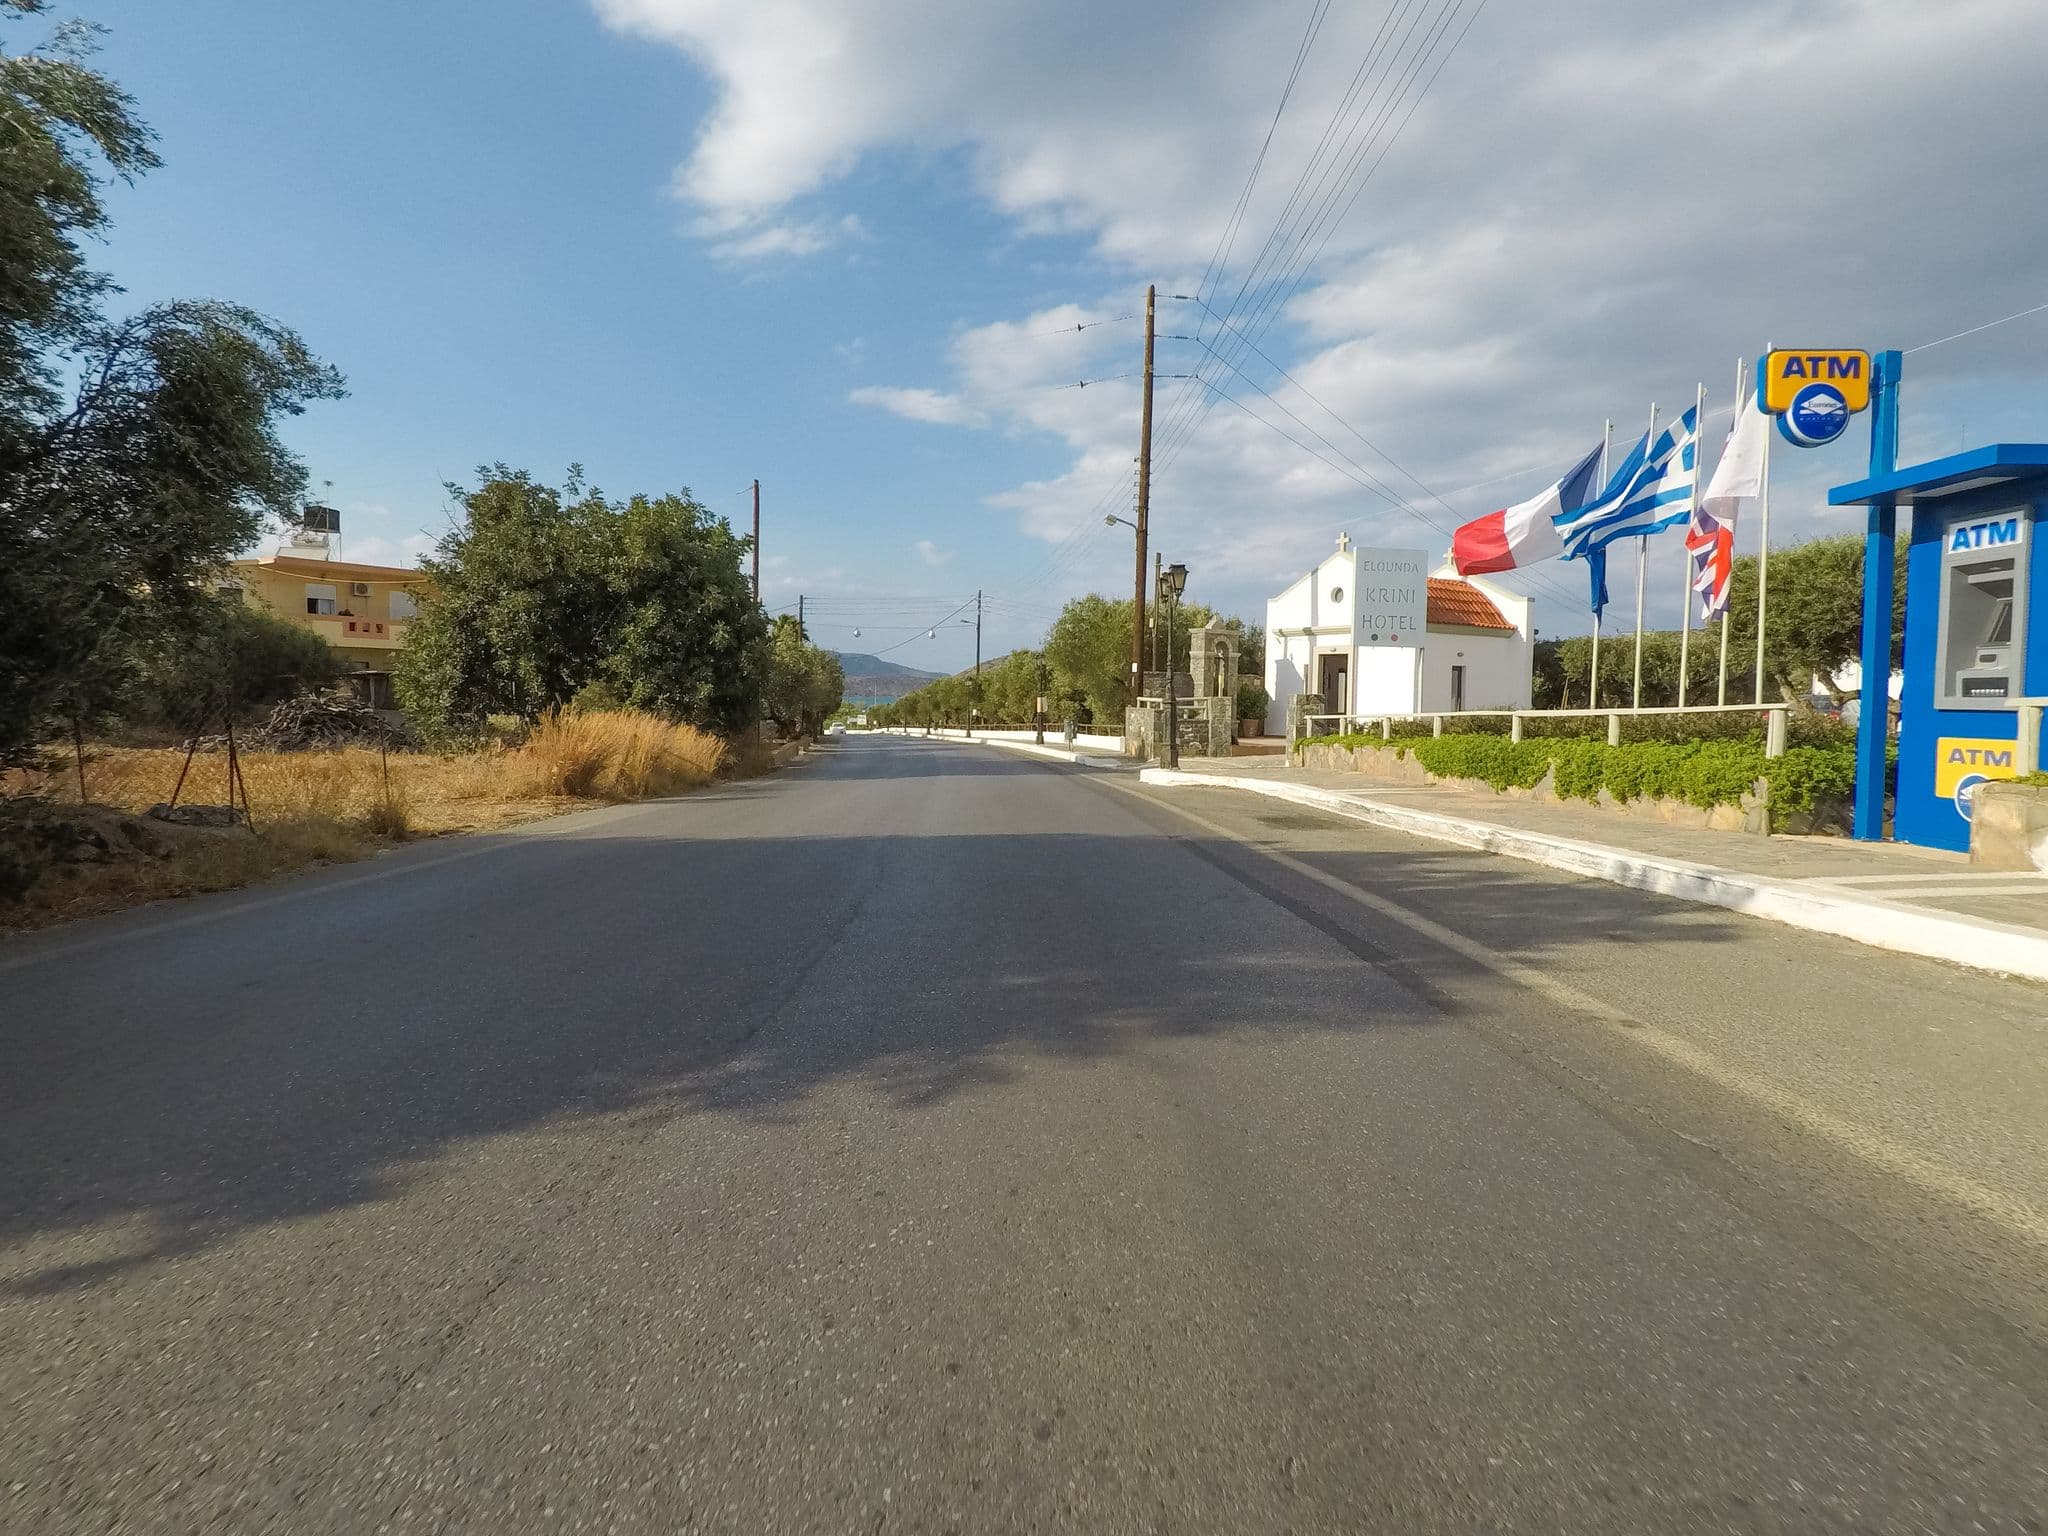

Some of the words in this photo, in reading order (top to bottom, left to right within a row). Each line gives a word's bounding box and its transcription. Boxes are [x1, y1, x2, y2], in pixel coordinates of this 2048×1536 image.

[1782, 356, 1861, 378] ATM
[1952, 518, 2017, 550] ATM
[1363, 560, 1419, 573] ELOUNDA
[1365, 587, 1416, 604] KRINI
[1361, 614, 1417, 630] HOTEL
[1948, 748, 2012, 767] ATM
